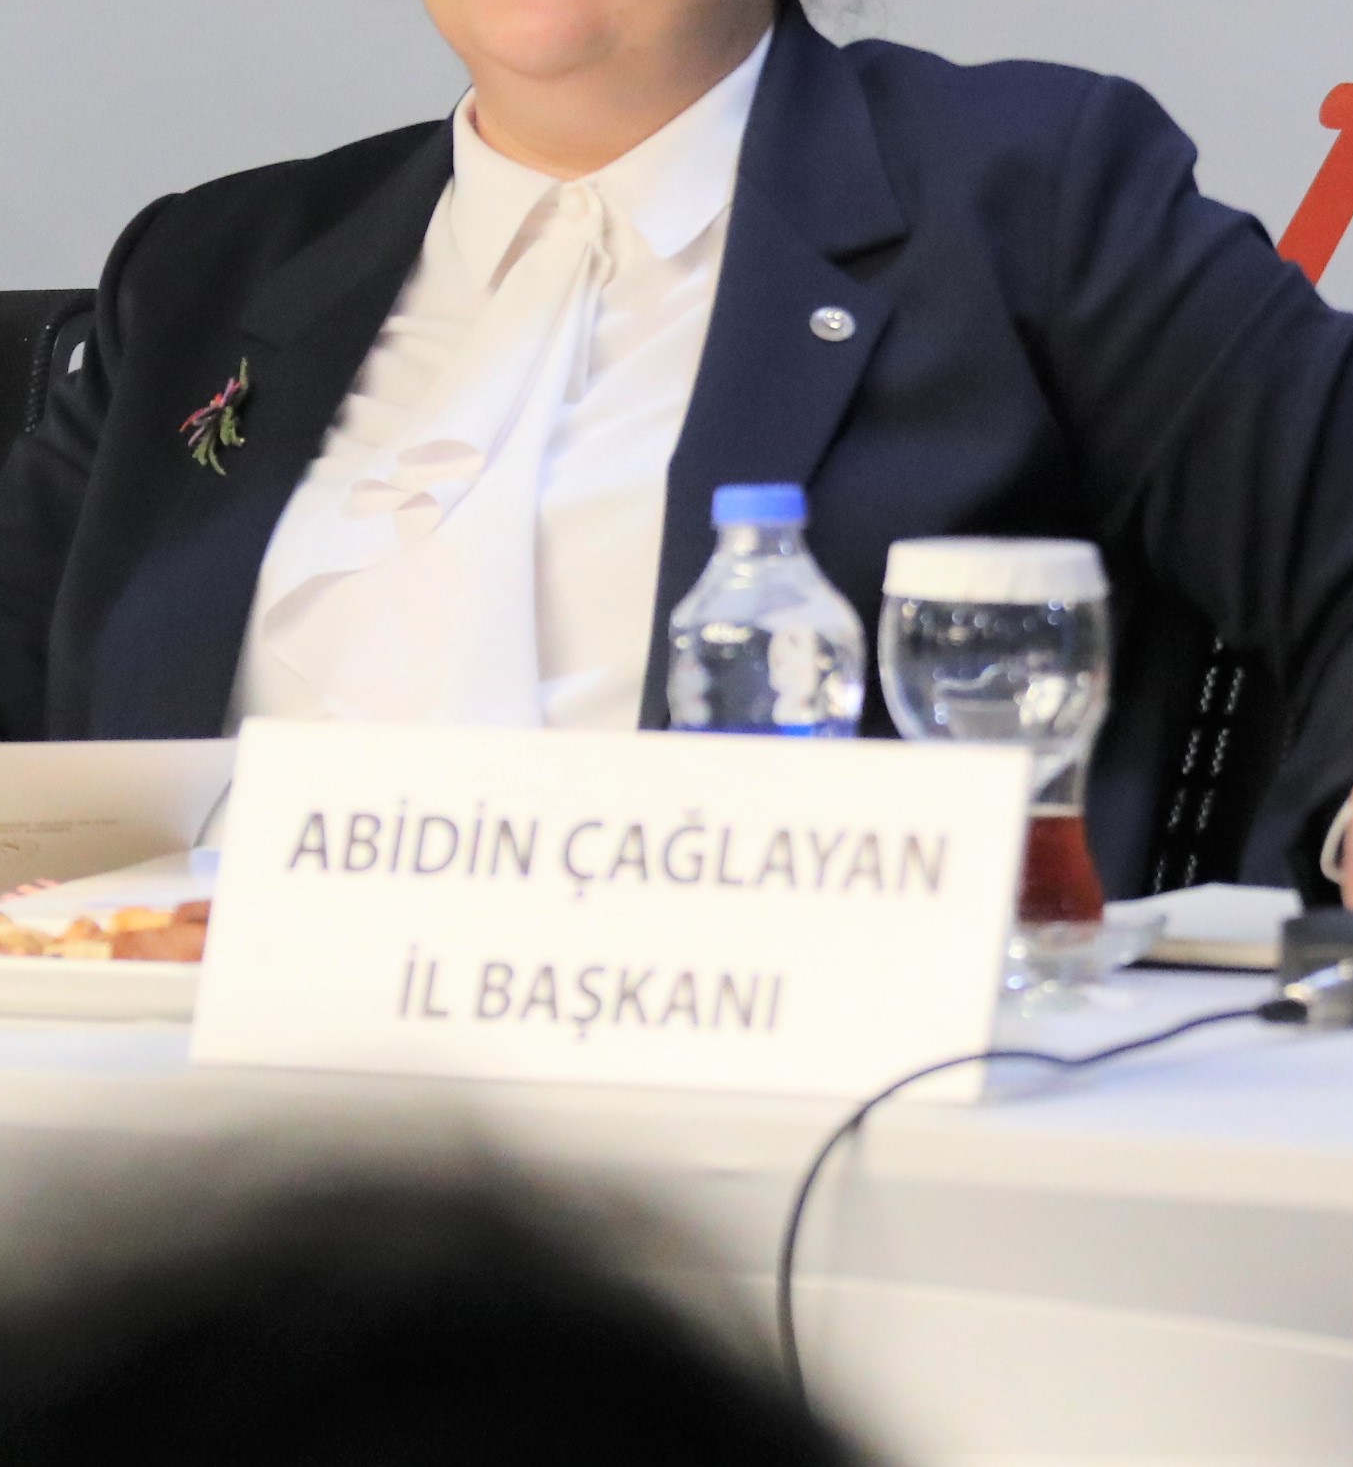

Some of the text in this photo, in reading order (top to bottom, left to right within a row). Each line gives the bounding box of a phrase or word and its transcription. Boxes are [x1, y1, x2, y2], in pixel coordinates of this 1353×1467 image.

[288, 799, 950, 899] ABİDİN ÇAĞLAYAN
[398, 944, 785, 1041] İL BAŞKANI
